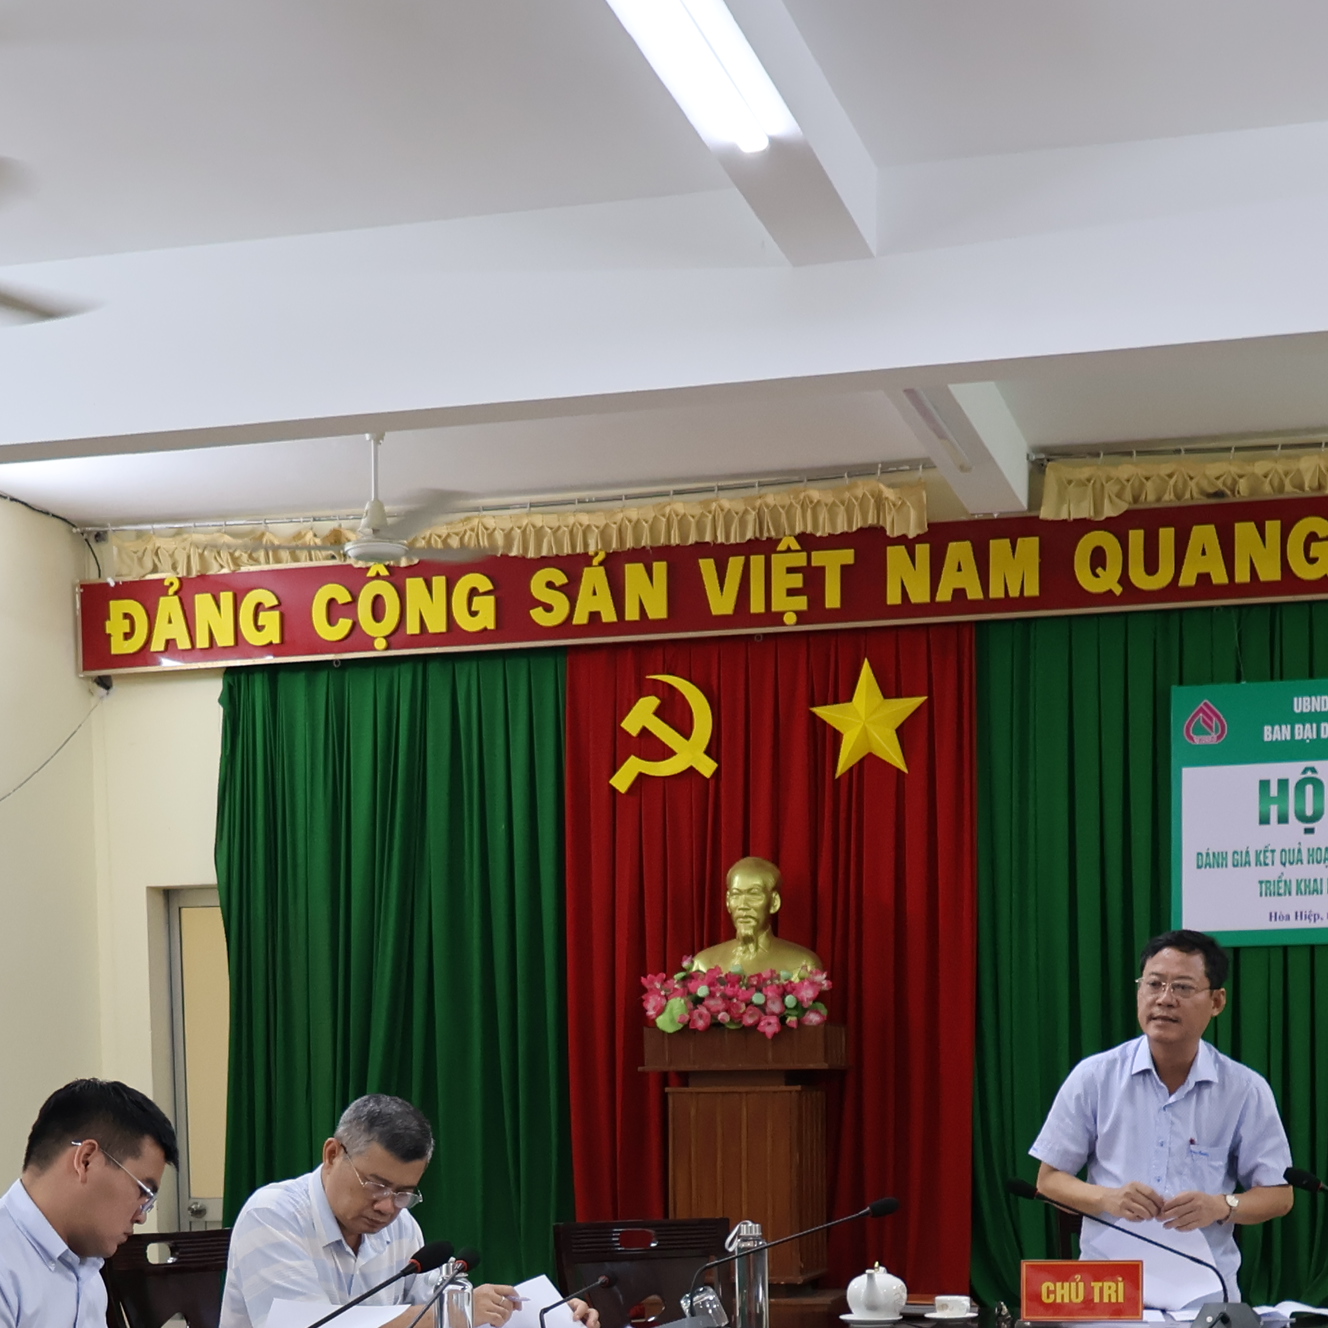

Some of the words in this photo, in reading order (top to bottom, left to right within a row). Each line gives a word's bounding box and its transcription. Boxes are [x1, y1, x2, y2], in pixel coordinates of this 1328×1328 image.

[105, 576, 282, 655] ĐẢNG
[312, 563, 496, 651] CỘNG
[529, 550, 668, 627] SẢN
[699, 536, 855, 626] VIỆT
[886, 537, 1040, 605] NAM
[1293, 695, 1328, 712] UBND
[1263, 724, 1290, 741] BAN
[1294, 723, 1316, 742] ĐẠI
[1196, 847, 1228, 869] ĐÁNH
[1231, 846, 1251, 867] GIÁ
[1254, 843, 1276, 866] KẾT
[1279, 841, 1303, 867] QUẢ
[1257, 872, 1291, 897] TRIỂN
[1295, 877, 1323, 895] KHAI
[1041, 1274, 1085, 1303] CHỦ
[1090, 1276, 1125, 1303] TRÌ
